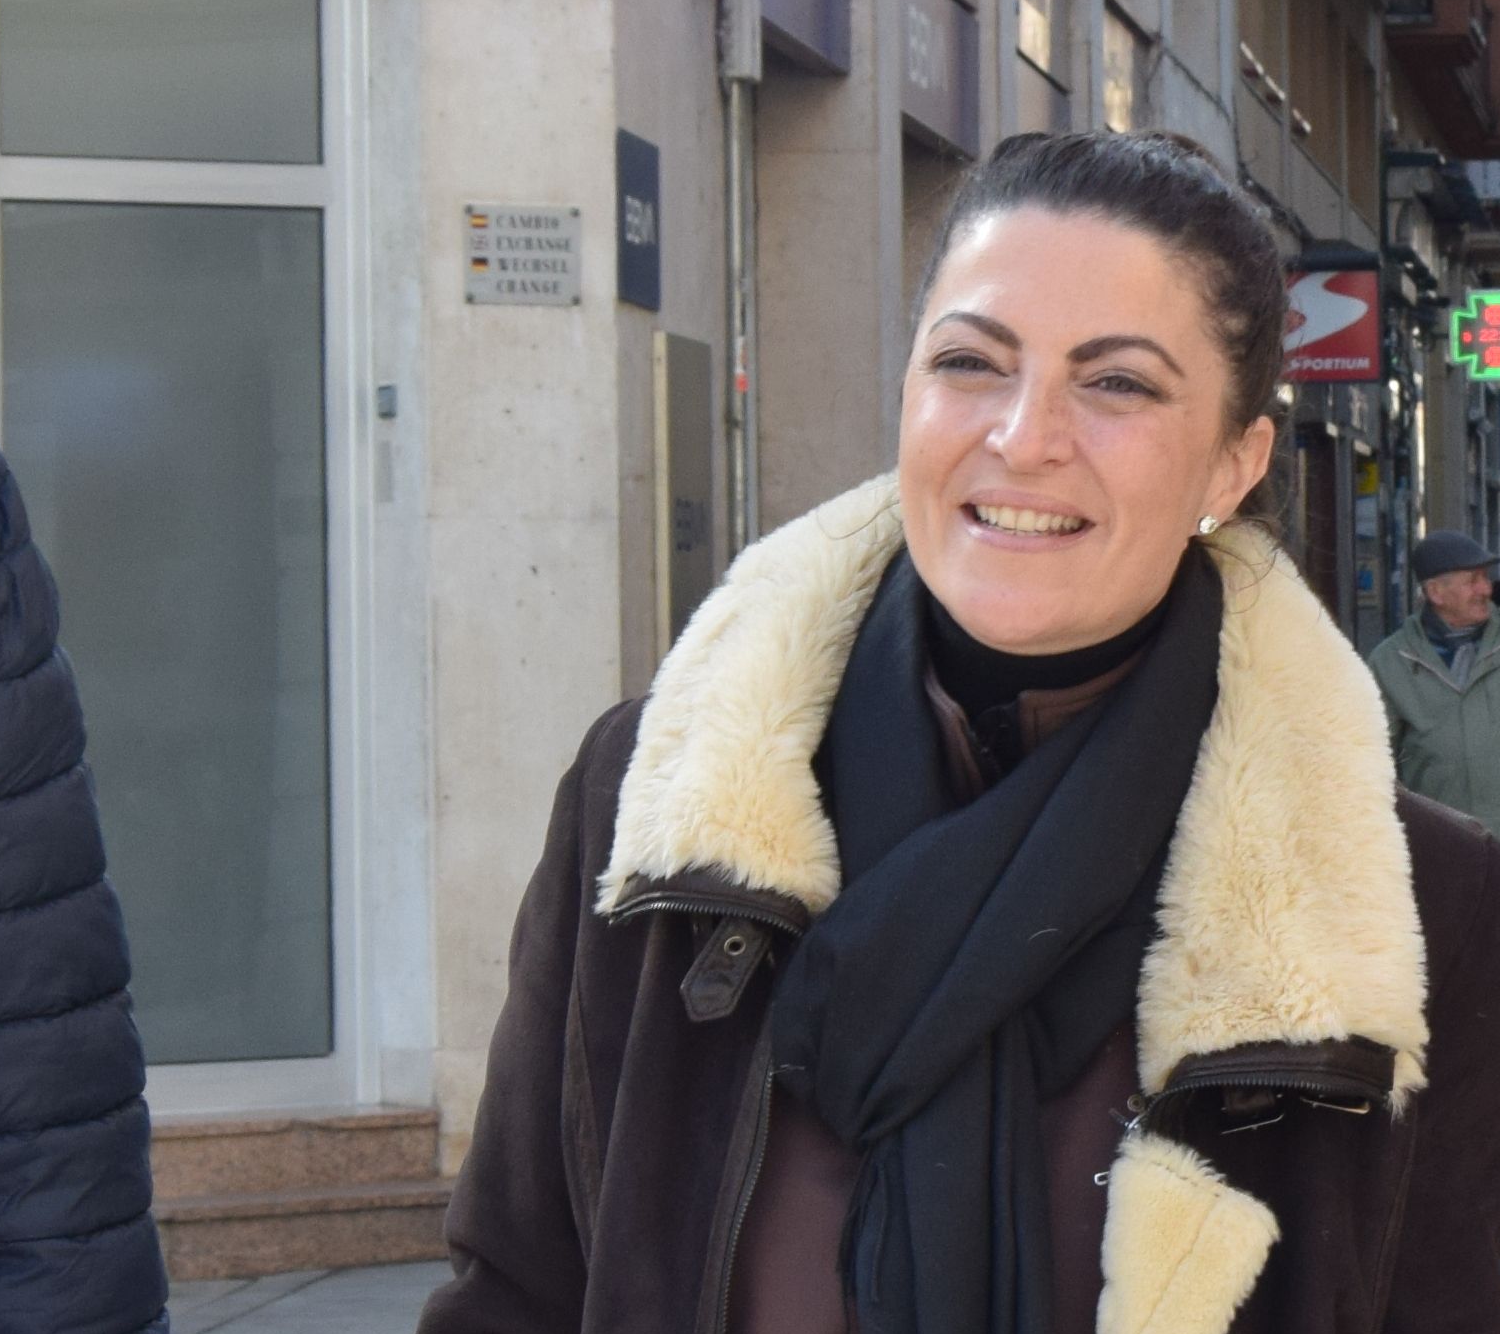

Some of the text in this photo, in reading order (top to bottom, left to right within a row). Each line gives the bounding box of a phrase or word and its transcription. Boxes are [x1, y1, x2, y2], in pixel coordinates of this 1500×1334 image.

[496, 215, 560, 229] CAMBIO
[496, 236, 572, 252] EXCHANGE
[497, 257, 569, 273] WECHSEL
[496, 280, 562, 294] CHANGE
